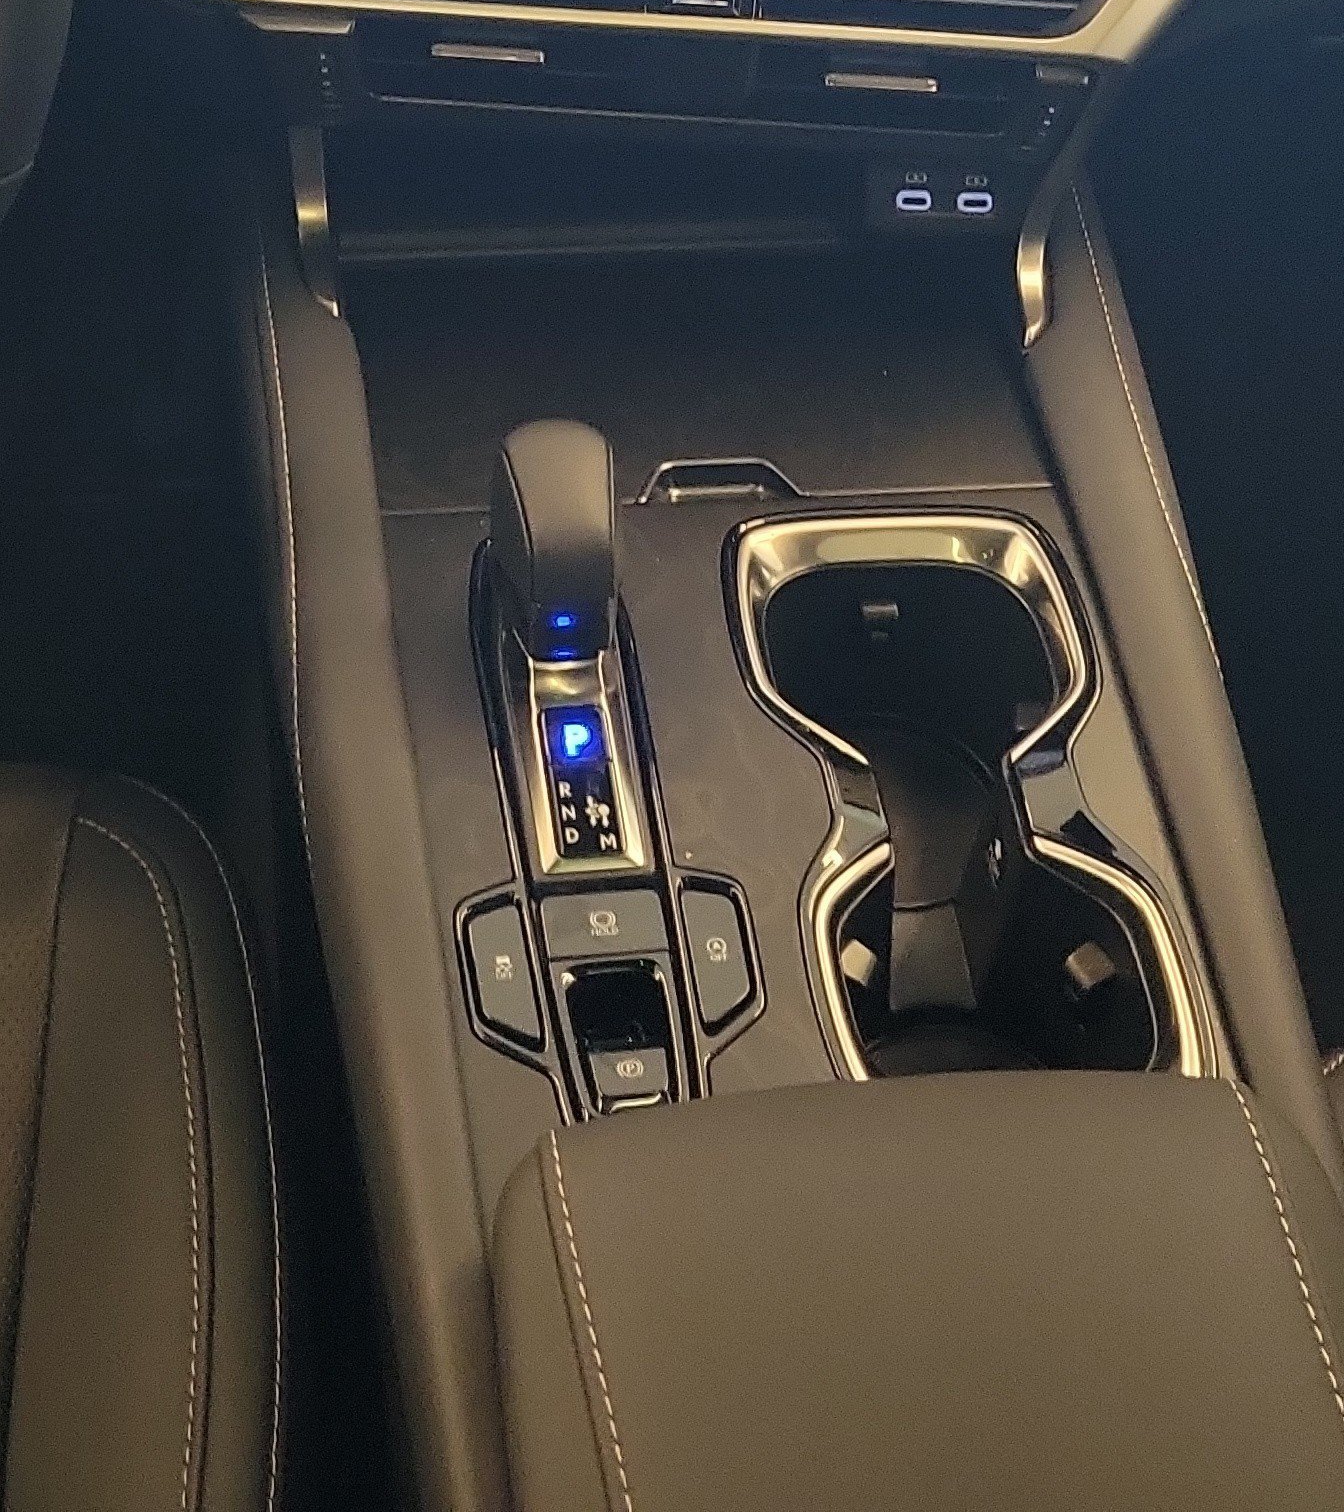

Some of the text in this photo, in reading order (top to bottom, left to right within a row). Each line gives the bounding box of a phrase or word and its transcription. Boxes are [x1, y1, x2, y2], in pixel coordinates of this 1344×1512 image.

[562, 722, 590, 757] P
[558, 781, 572, 800] R
[560, 804, 576, 821] N
[565, 827, 580, 846] D
[599, 833, 617, 850] M
